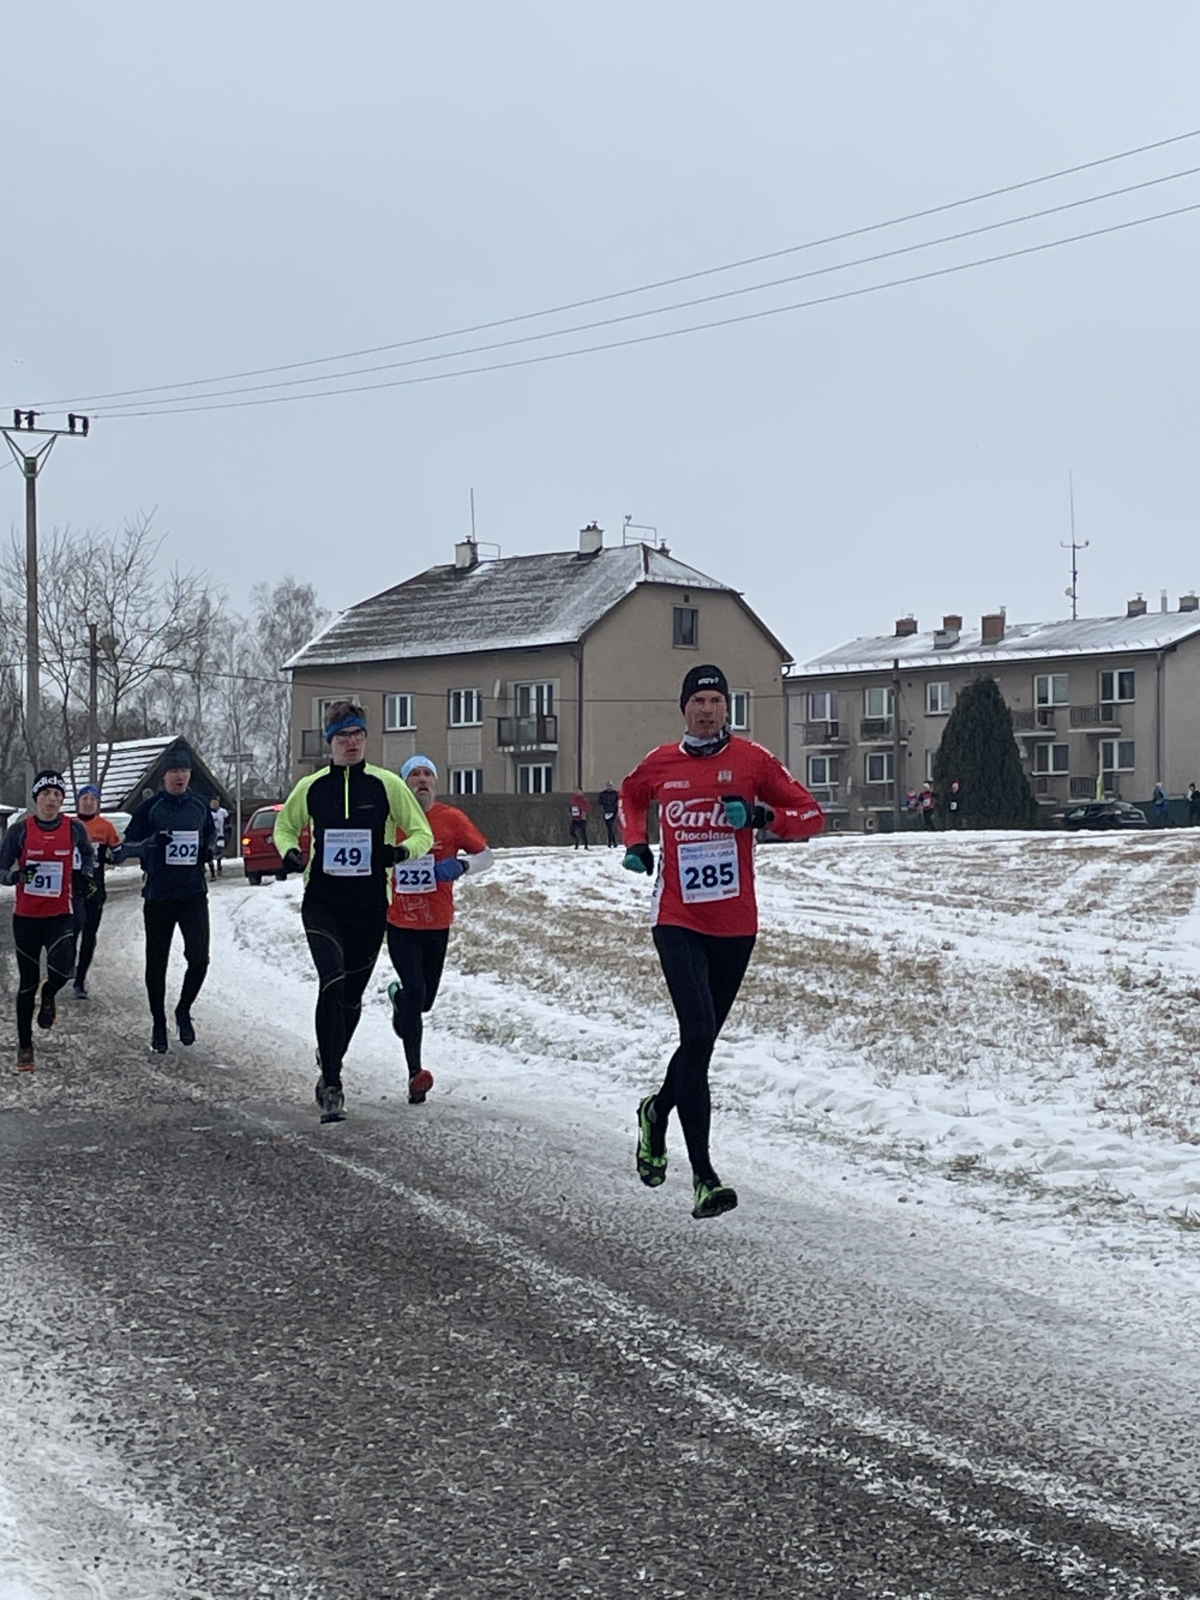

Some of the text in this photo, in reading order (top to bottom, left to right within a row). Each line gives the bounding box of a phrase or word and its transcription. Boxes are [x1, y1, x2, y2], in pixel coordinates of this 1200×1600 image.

[169, 844, 197, 857] 202
[333, 848, 361, 866] 49
[35, 875, 52, 889] 91
[399, 870, 432, 885] 232
[685, 863, 734, 890] 285
